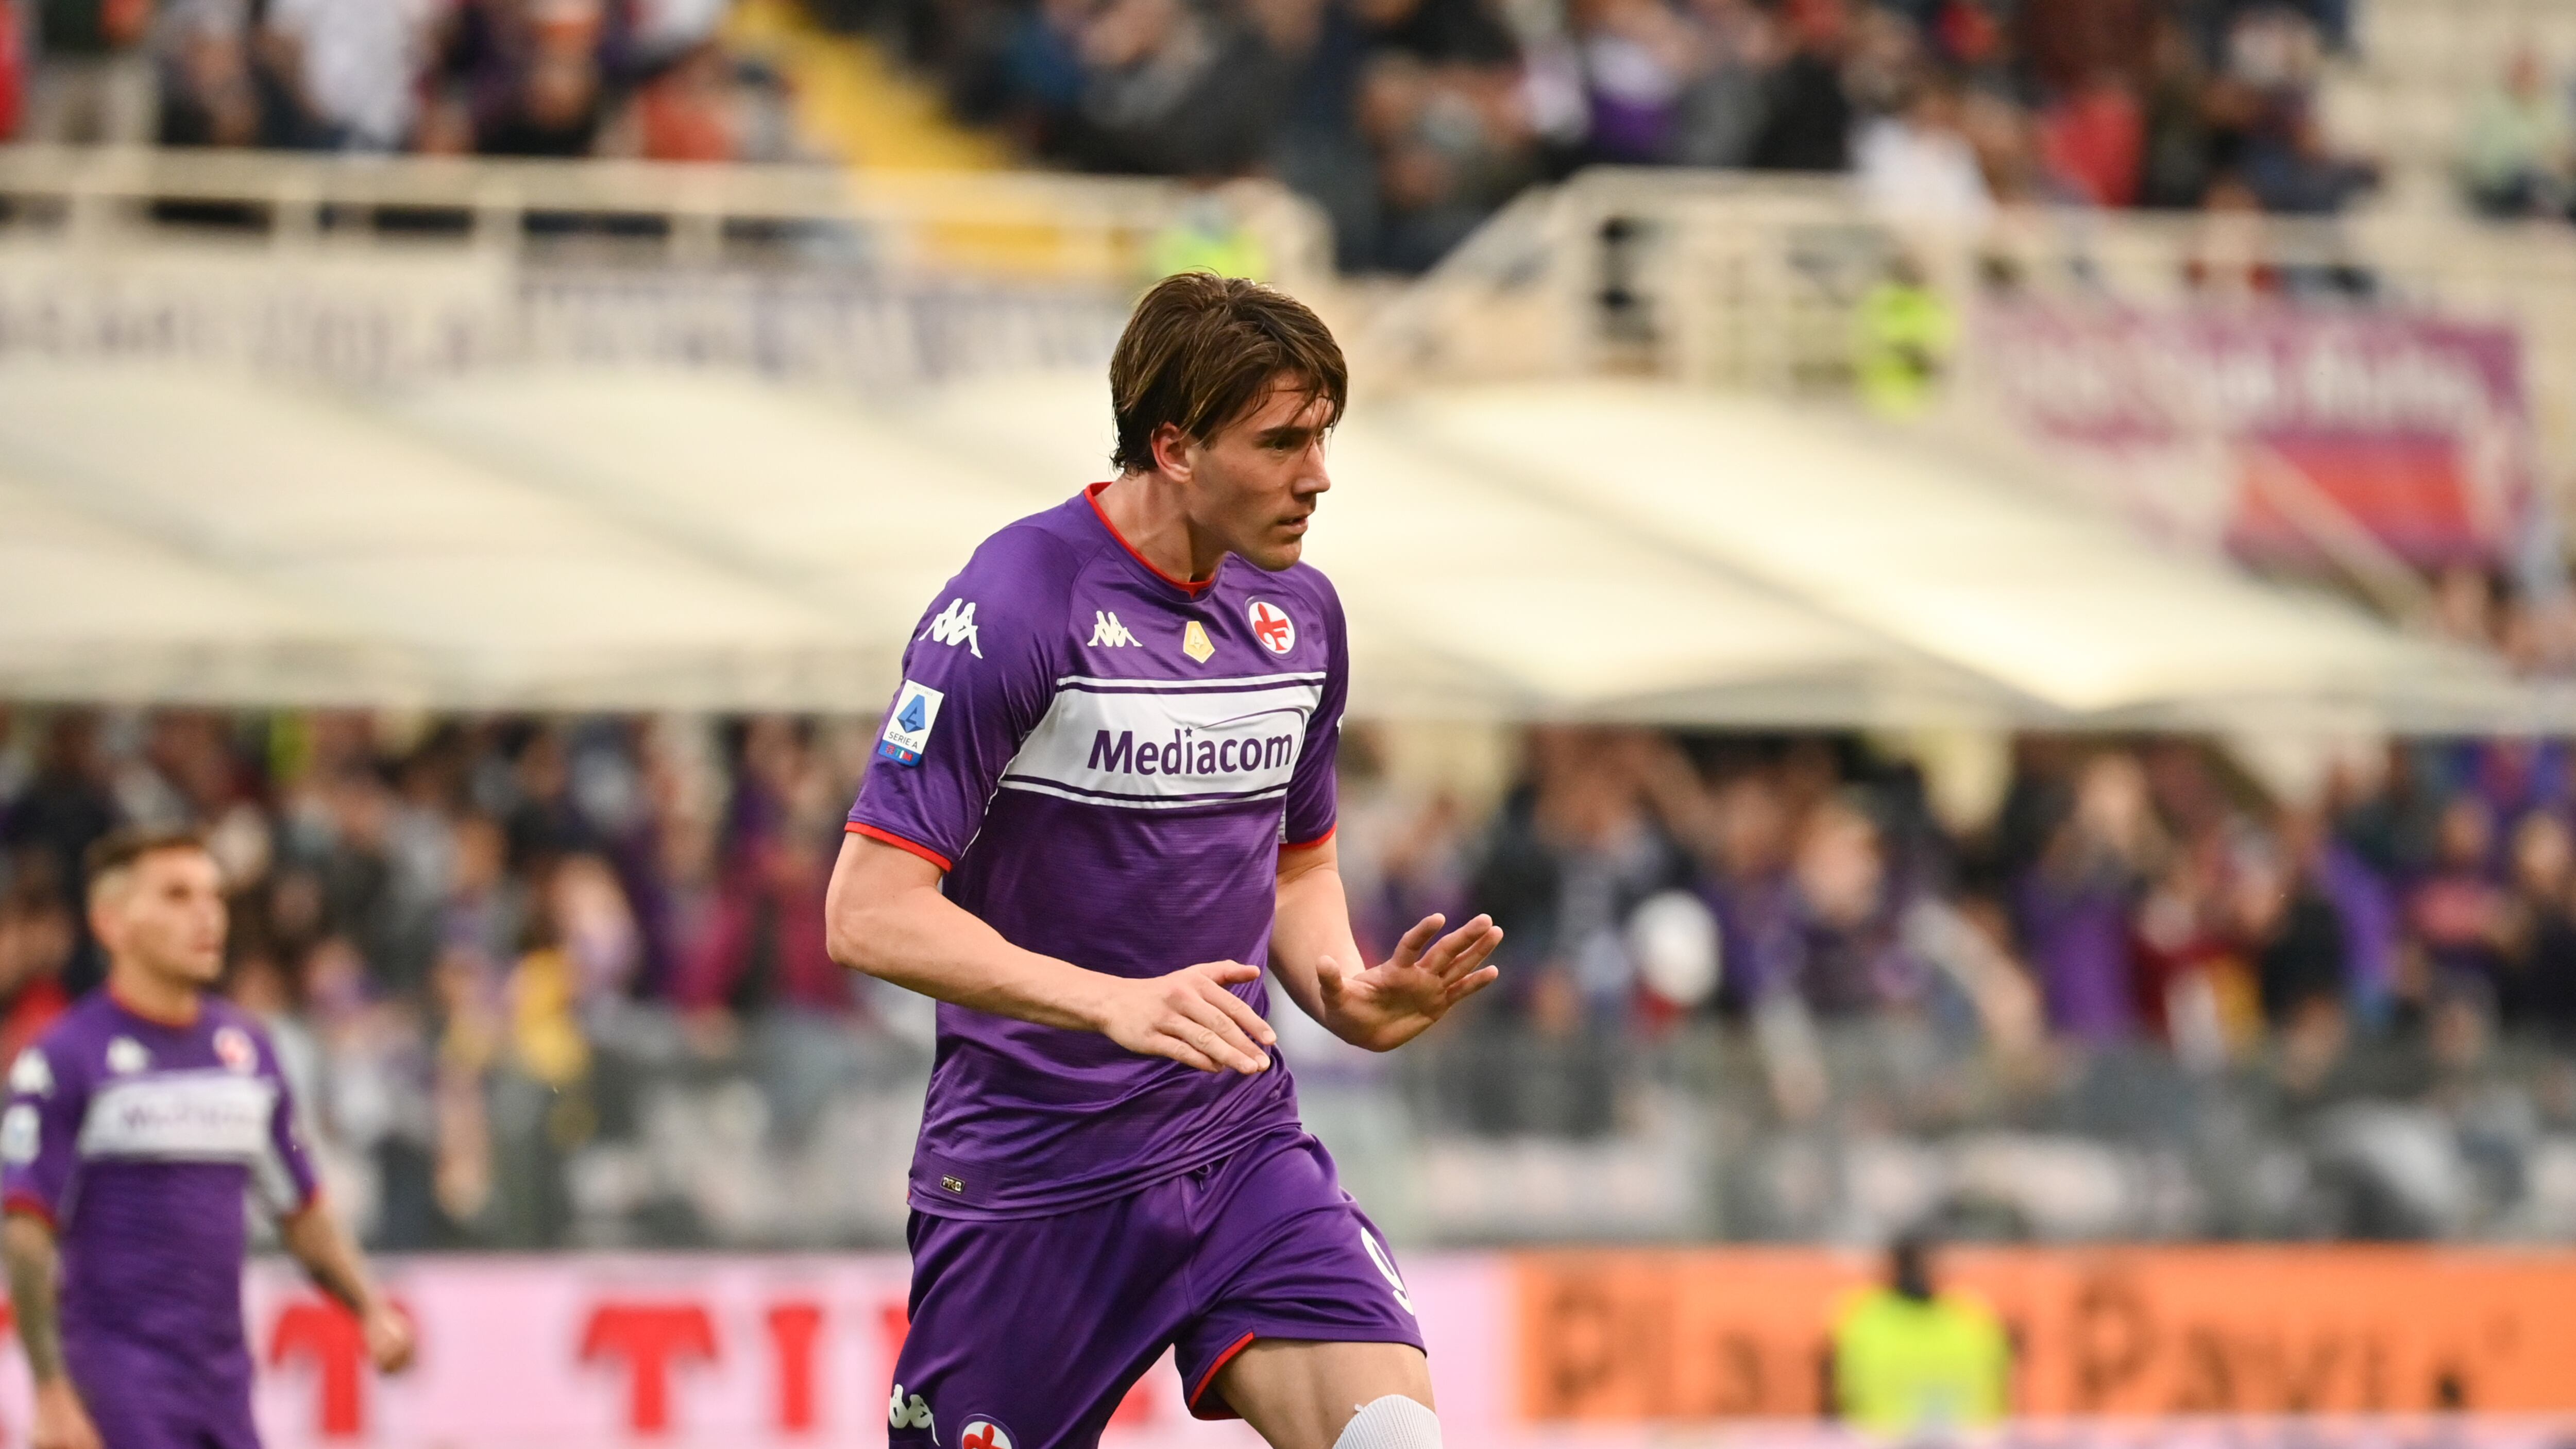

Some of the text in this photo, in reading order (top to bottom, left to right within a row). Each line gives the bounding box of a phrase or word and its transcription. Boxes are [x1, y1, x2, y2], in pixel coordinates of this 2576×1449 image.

[888, 731, 918, 749] SERIE A
[895, 748, 913, 761] TIM
[1087, 726, 1293, 776] Mediacom
[1361, 1227, 1414, 1316] 9
